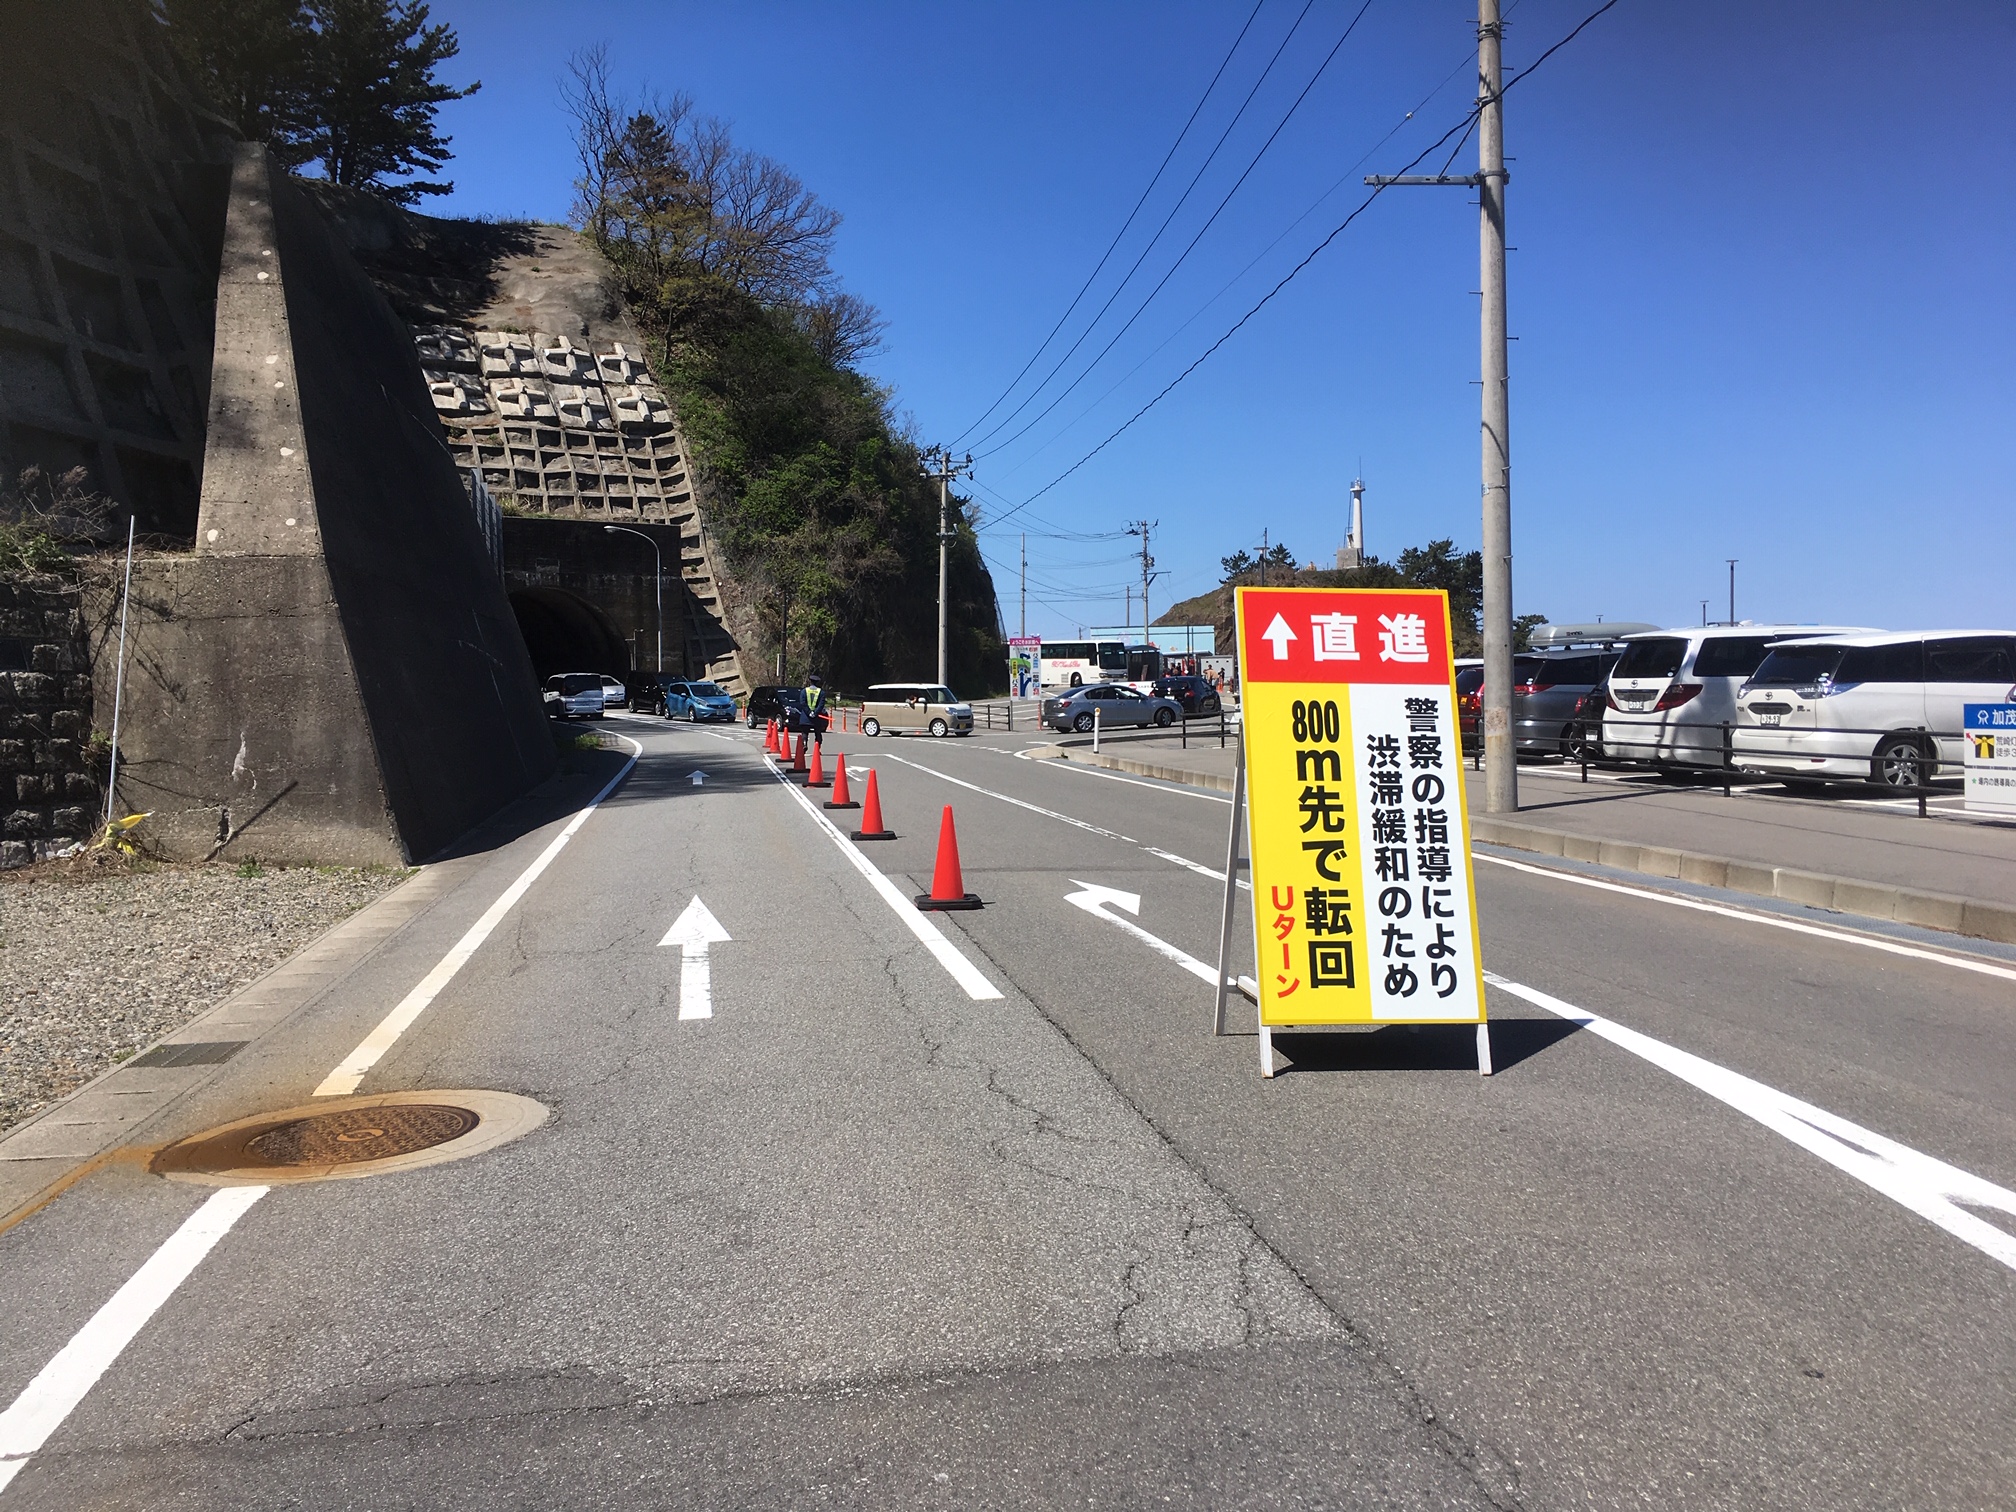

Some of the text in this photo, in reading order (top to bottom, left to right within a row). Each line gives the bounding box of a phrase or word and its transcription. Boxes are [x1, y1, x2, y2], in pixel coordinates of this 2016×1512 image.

[1310, 612, 1431, 663] 直進
[1271, 885, 1300, 999] Uターン
[1292, 700, 1356, 990] 800m先で転回
[1366, 734, 1419, 998] 渋滞緩和のため
[1404, 697, 1458, 999] 警察の指導により
